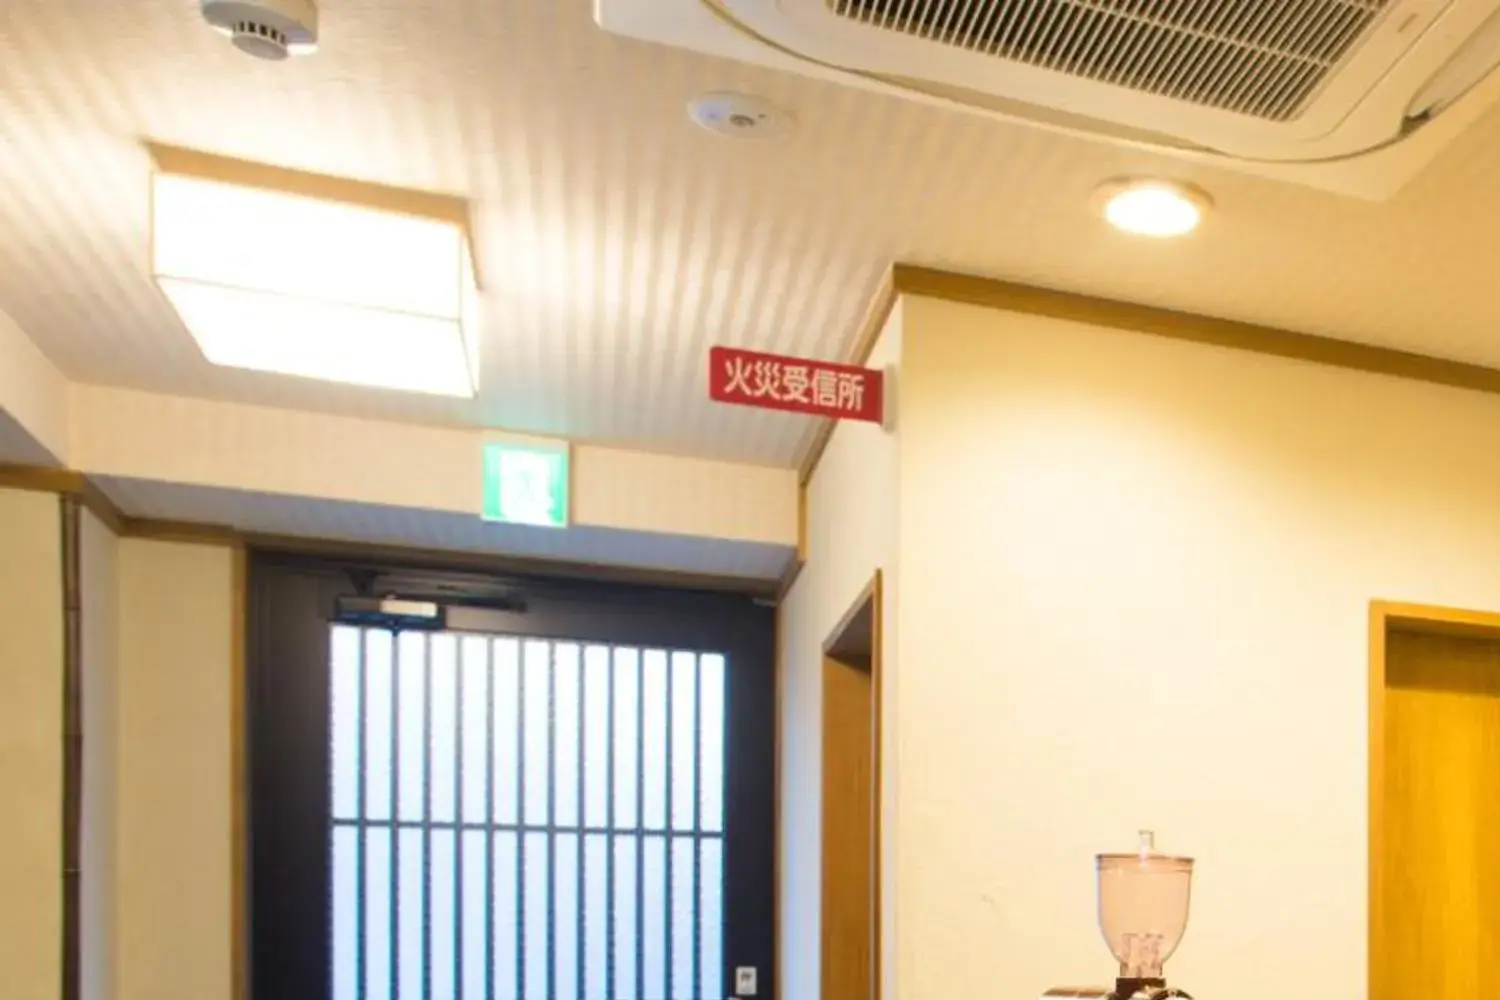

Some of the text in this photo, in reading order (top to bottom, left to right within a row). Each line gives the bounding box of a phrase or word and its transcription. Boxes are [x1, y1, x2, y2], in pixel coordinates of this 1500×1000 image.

[724, 356, 865, 411] 火災受信所
